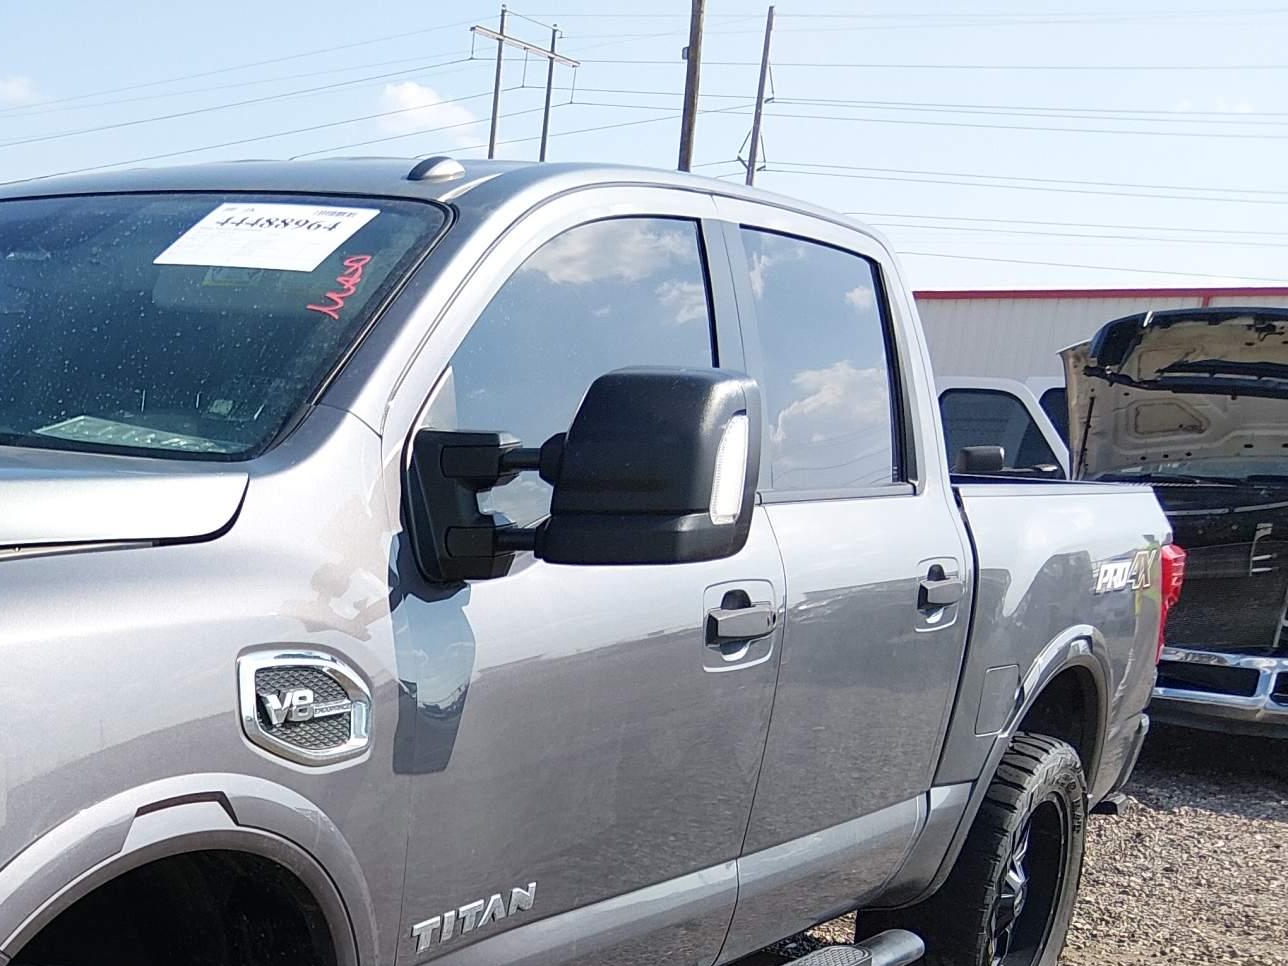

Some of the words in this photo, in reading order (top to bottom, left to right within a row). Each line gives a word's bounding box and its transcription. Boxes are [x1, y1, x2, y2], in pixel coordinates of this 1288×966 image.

[216, 213, 339, 233] 44488964
[263, 689, 314, 725] V8
[411, 882, 537, 954] TITAN
